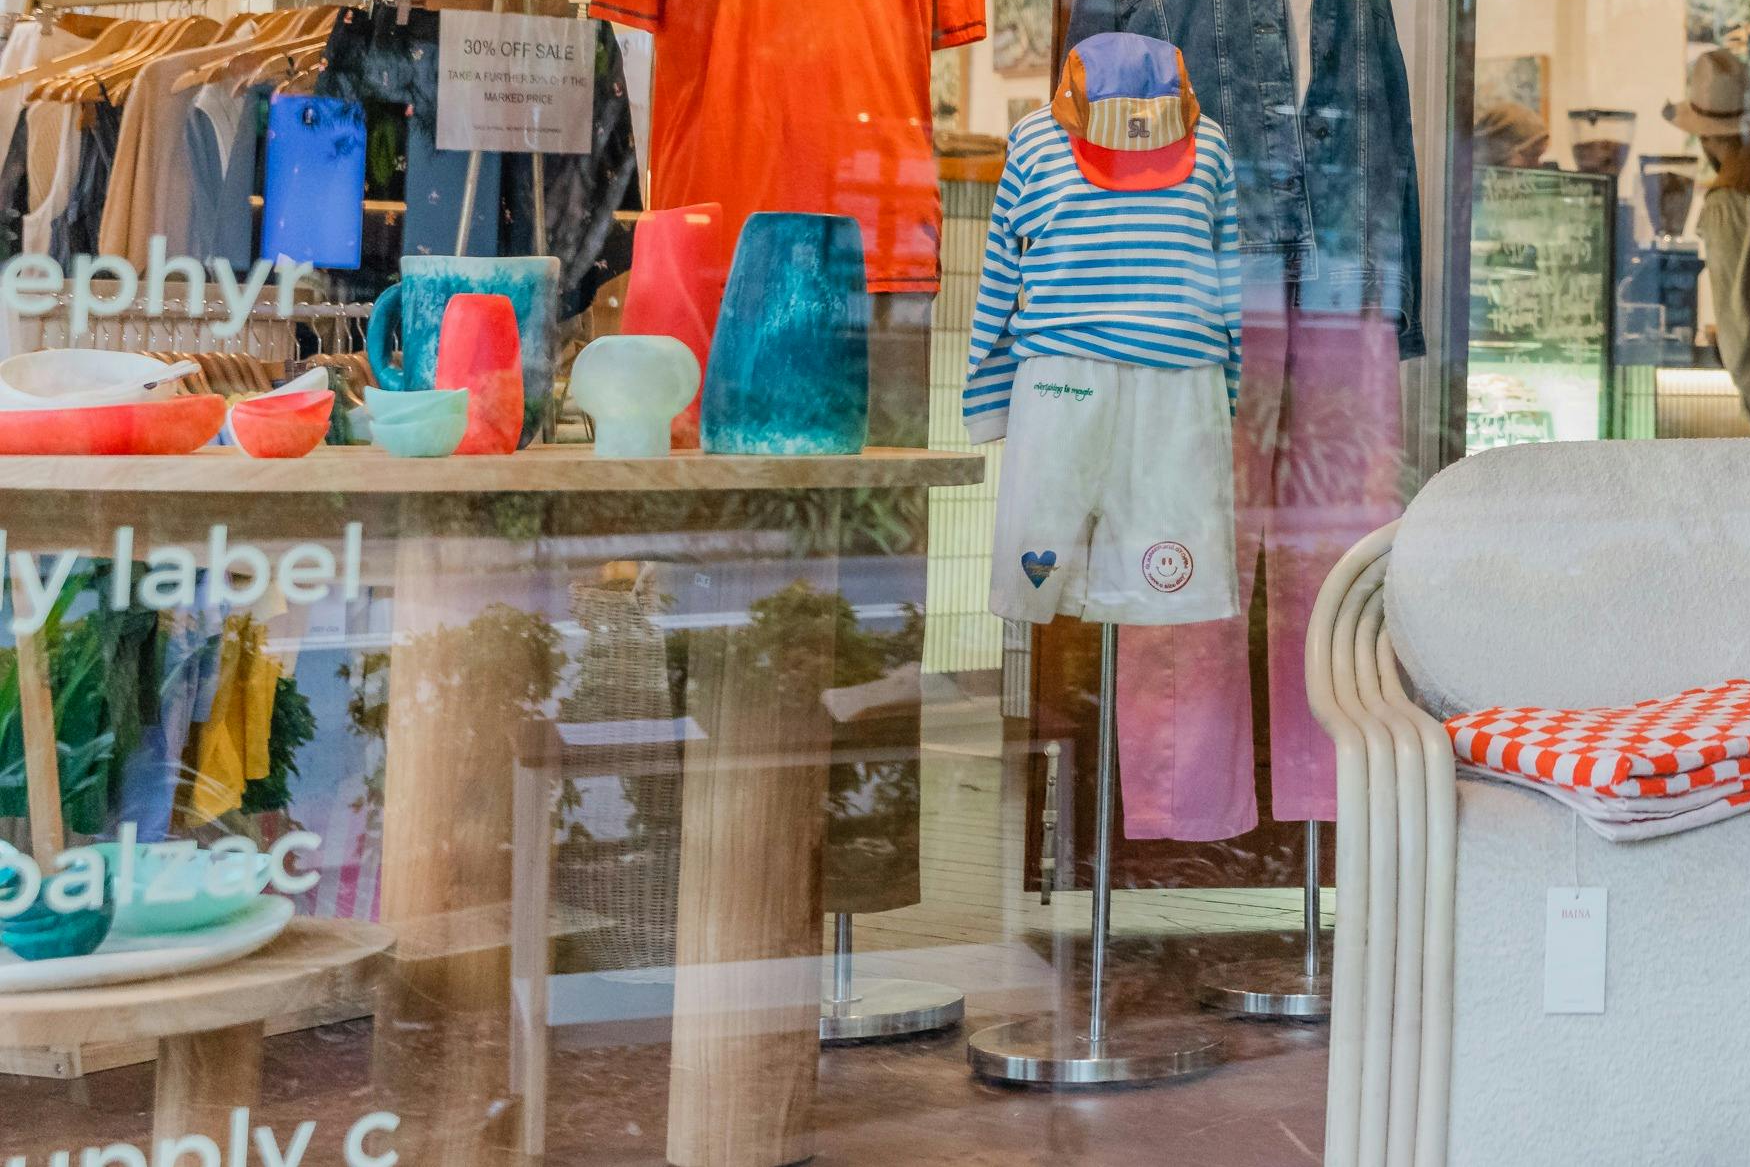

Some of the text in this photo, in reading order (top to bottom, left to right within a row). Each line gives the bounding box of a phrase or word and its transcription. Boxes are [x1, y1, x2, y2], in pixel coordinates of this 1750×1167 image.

[463, 39, 574, 61] 30% OFF SALE
[448, 70, 471, 82] TAKE
[484, 73, 527, 85] FURTHER
[484, 92, 553, 105] MARKED PRICE
[111, 521, 363, 611] label
